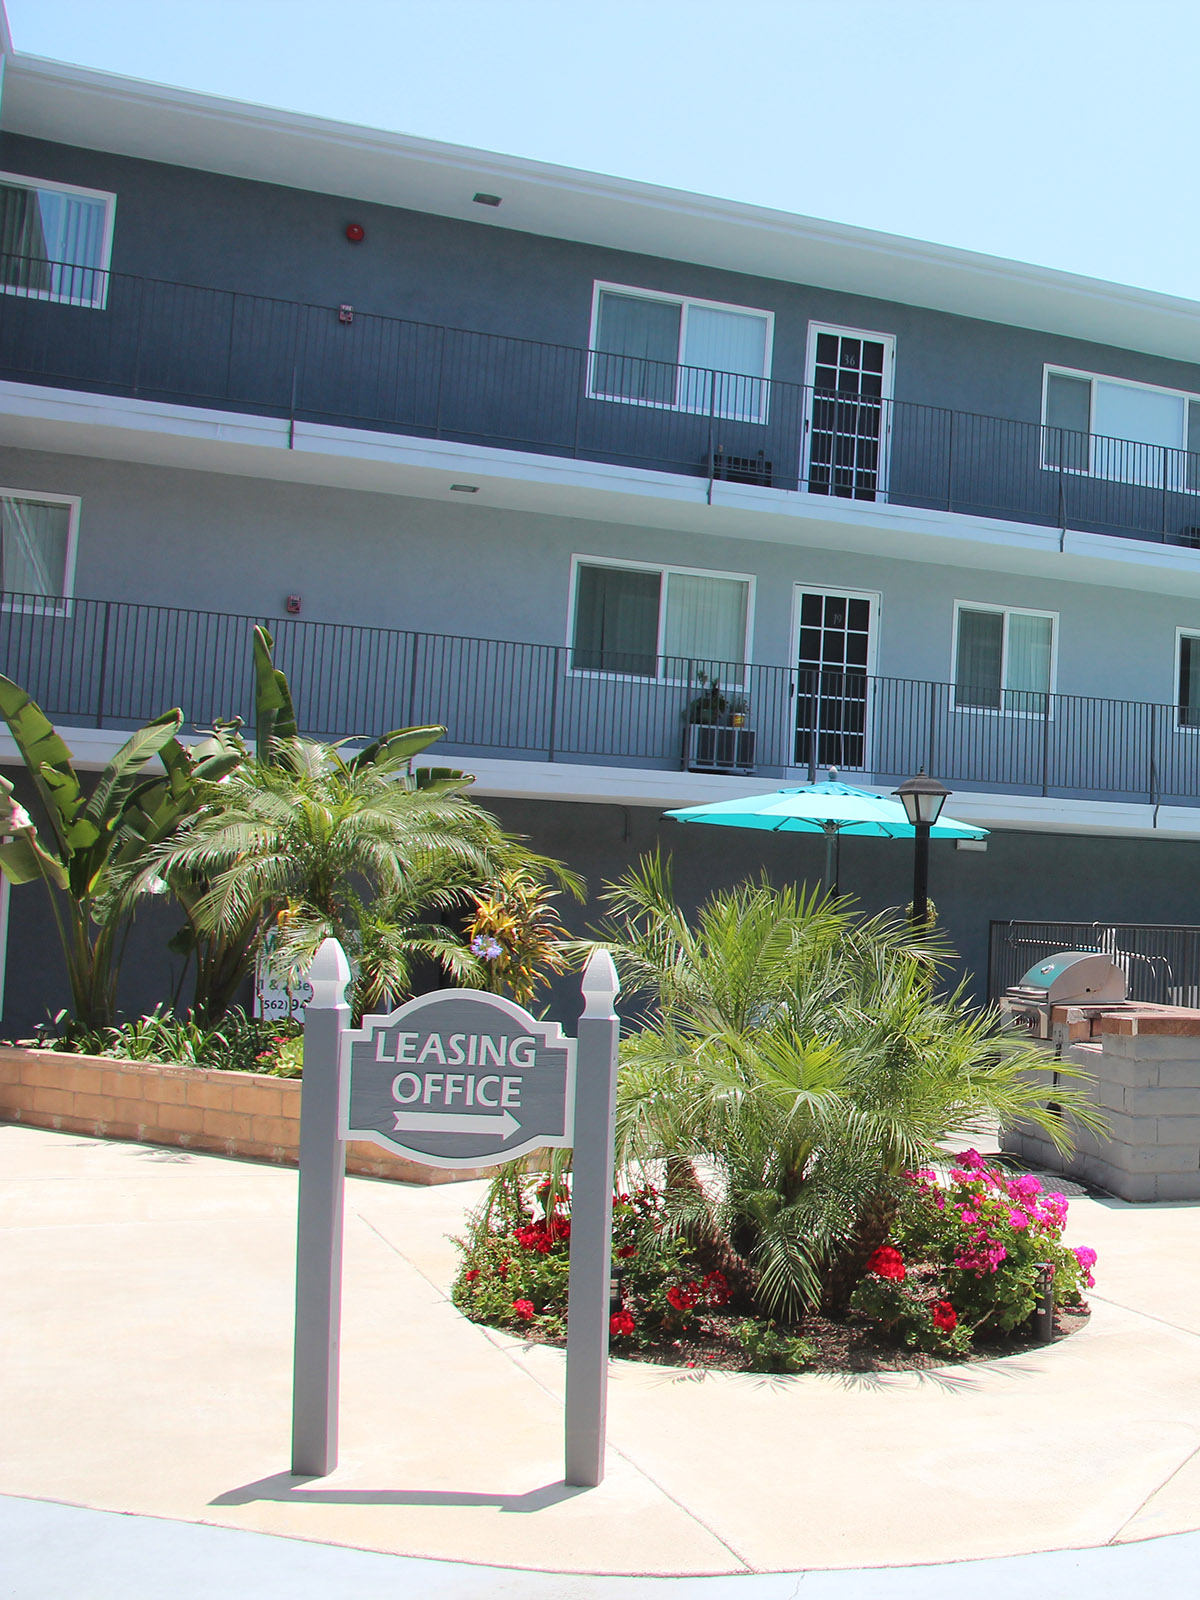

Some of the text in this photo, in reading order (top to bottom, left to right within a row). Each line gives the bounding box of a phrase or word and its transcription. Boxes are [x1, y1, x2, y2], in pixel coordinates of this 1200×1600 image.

[844, 354, 855, 366] 36
[263, 1000, 288, 1011] 562)
[375, 1031, 537, 1068] LEASING
[391, 1071, 523, 1108] OFFICE
